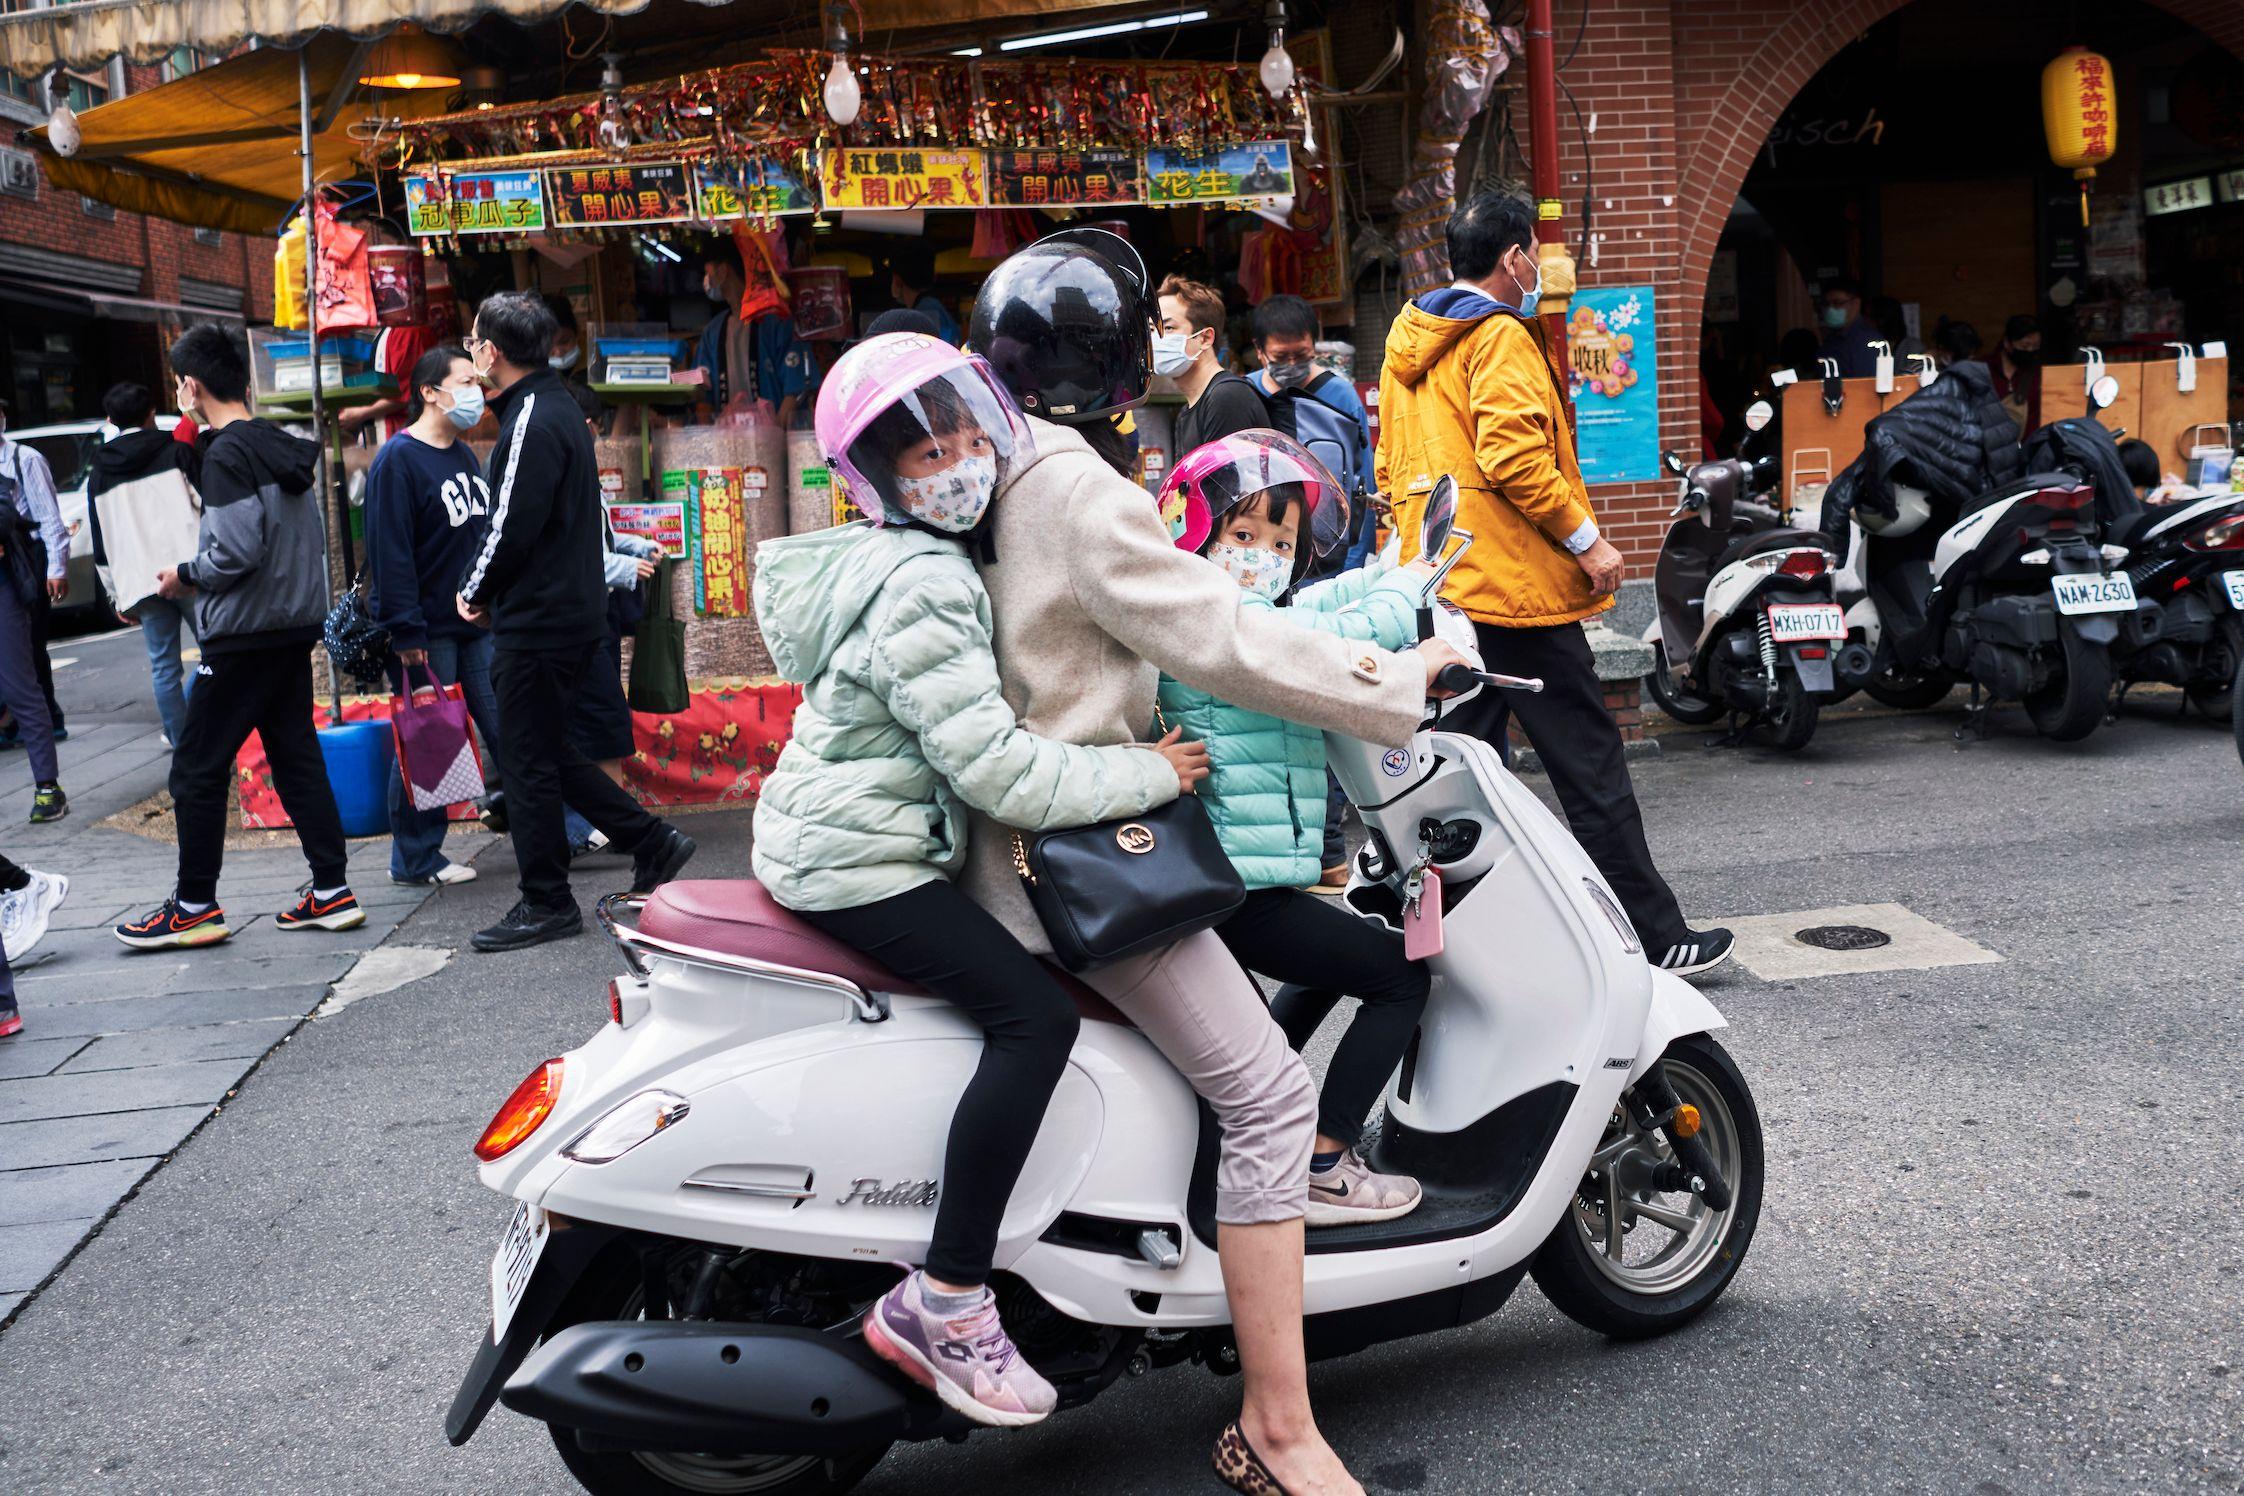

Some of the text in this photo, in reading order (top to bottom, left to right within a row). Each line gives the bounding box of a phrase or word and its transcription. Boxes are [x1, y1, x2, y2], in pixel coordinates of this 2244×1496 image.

[850, 152, 925, 175] 紅螞蟻
[1013, 151, 1083, 175] 夏威夷
[425, 179, 494, 202] 販售
[570, 167, 635, 194] 夏威夷
[861, 177, 956, 207] 開心果
[1022, 174, 1113, 204] 開心果
[1156, 168, 1237, 199] 花生
[581, 190, 664, 223] 開心果
[704, 183, 783, 214] 花生
[419, 198, 535, 231] 冠軍瓜子
[703, 488, 734, 600] 奶油開心果
[2058, 582, 2131, 605] NAM-2630
[2231, 584, 2244, 603] 5
[1773, 614, 1840, 632] MXH-0717
[1608, 1060, 1629, 1068] ABS
